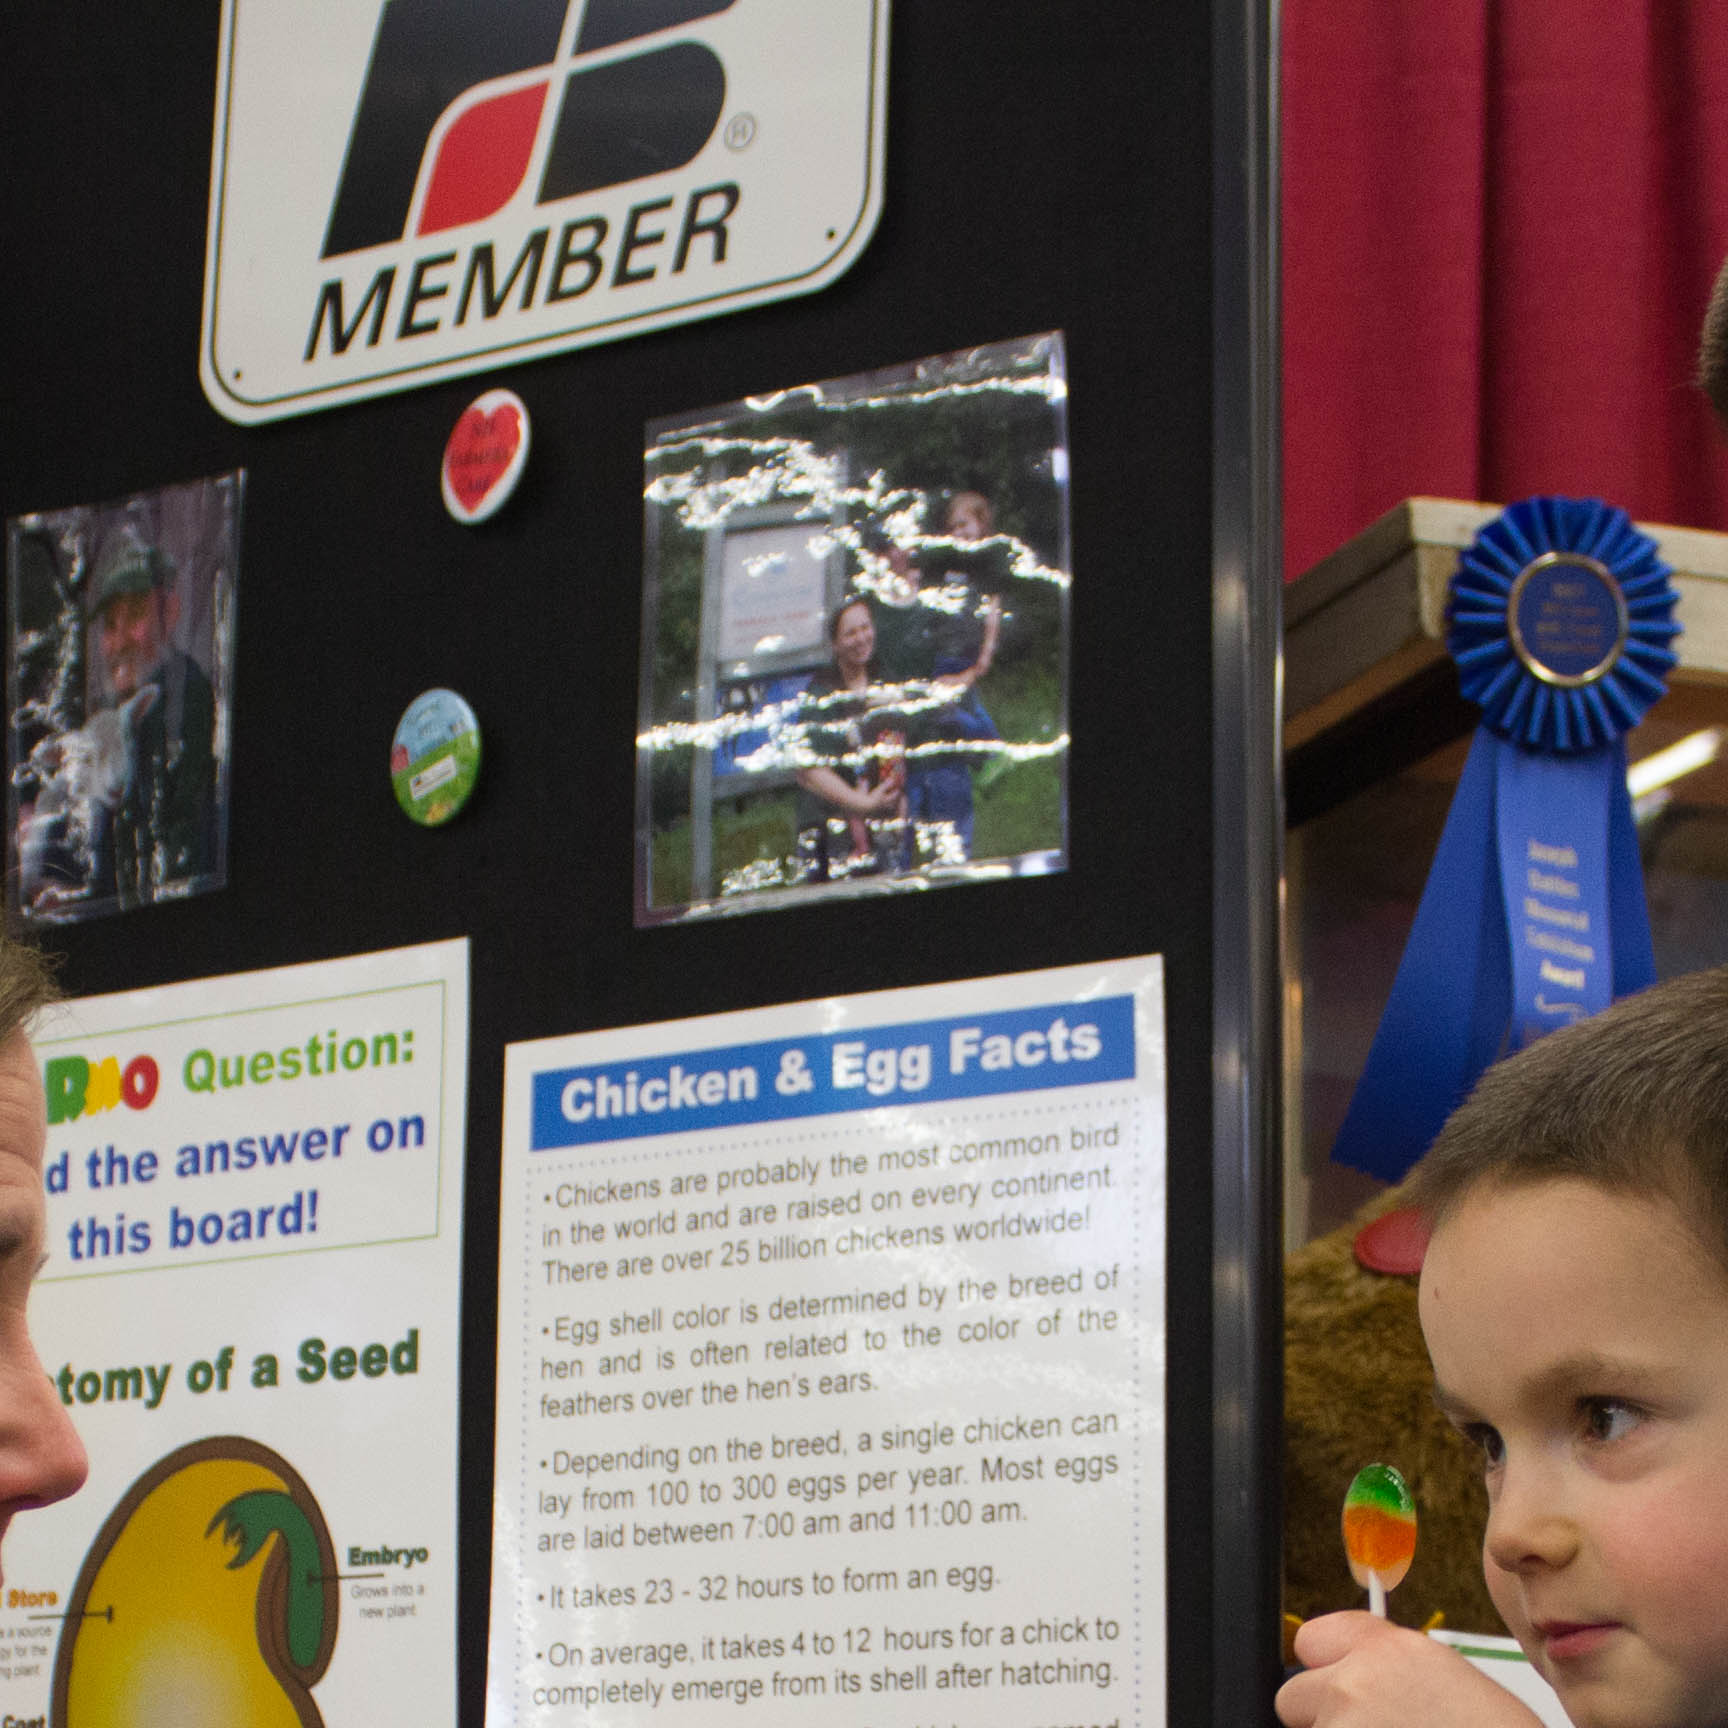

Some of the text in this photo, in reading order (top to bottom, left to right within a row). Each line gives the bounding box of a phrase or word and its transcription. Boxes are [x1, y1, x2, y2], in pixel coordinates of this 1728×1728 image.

[303, 181, 741, 363] MEMBER
[183, 1029, 415, 1094] Question:
[561, 1018, 1102, 1122] Chicken & Egg Facts
[86, 1145, 159, 1189] the
[175, 1122, 351, 1179] answer
[366, 1114, 427, 1154] on
[555, 1121, 1121, 1210] Chickens are probably the most common bird
[68, 1190, 320, 1261] this board!
[541, 1204, 1091, 1285] There are over 25 billion chickens worldwide!
[542, 1224, 562, 1248] in
[569, 1220, 606, 1246] the
[613, 1209, 677, 1240] world
[685, 1203, 730, 1233] and
[738, 1203, 778, 1227] are
[786, 1188, 862, 1221] raised
[870, 1189, 902, 1213] on
[910, 1182, 982, 1209] every
[50, 1328, 421, 1410] tomy of a Seed
[538, 1453, 1120, 1520] lay from 100 to 300 eggs per year. Most eggs
[349, 1545, 428, 1570] Embryo
[537, 1498, 1027, 1553] are laid between 7:00 am and 11:00 am.
[8, 1589, 58, 1608] Store
[351, 1585, 389, 1599] Grows
[359, 1602, 417, 1620] new plant
[549, 1584, 566, 1611] It
[571, 1582, 637, 1609] takes
[644, 1577, 675, 1606] 23
[698, 1574, 728, 1603] 32
[735, 1574, 805, 1600] hours
[811, 1570, 836, 1596] to
[842, 1567, 899, 1594] form
[906, 1567, 938, 1590] an
[945, 1564, 1001, 1594] egg.
[532, 1660, 1119, 1710] completely emerge from its shell after hatching.
